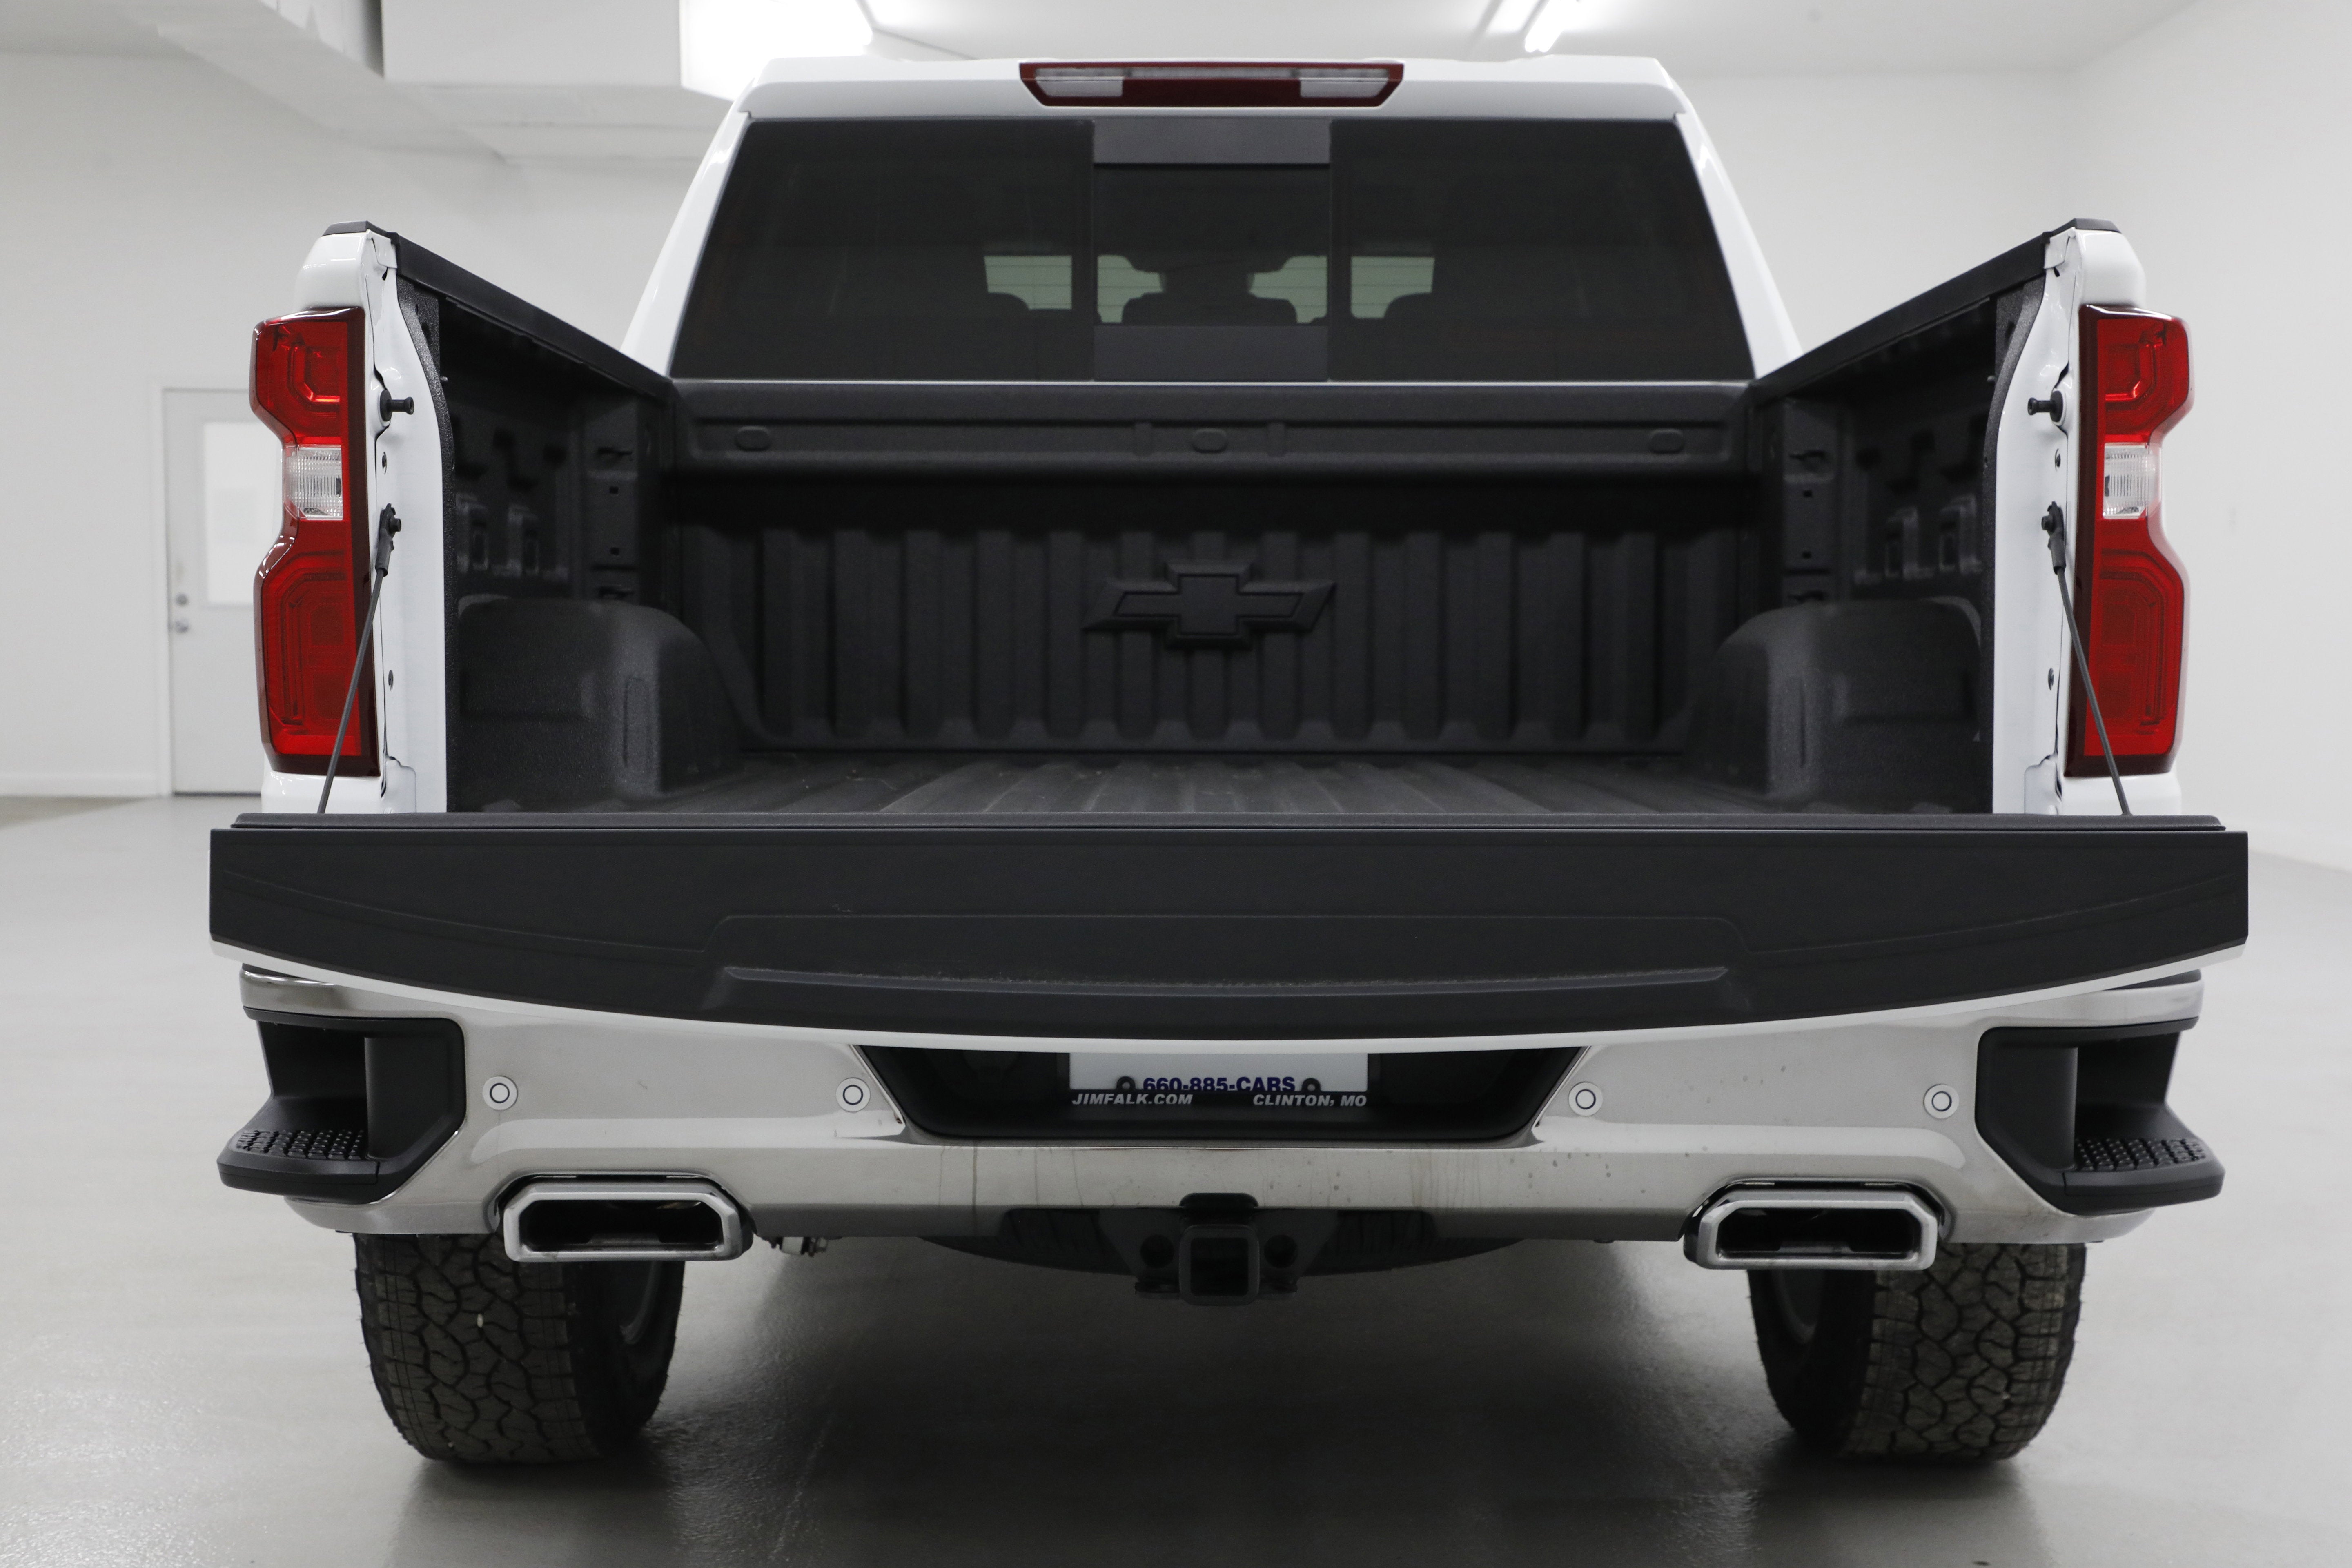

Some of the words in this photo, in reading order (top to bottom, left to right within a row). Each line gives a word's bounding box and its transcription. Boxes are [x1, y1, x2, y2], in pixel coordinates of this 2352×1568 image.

[1143, 1076, 1295, 1091] 660-885-CARS
[1072, 1093, 1193, 1105] JIMFALK.COM
[1253, 1094, 1334, 1106] CLINTON,
[1340, 1095, 1367, 1107] MO
